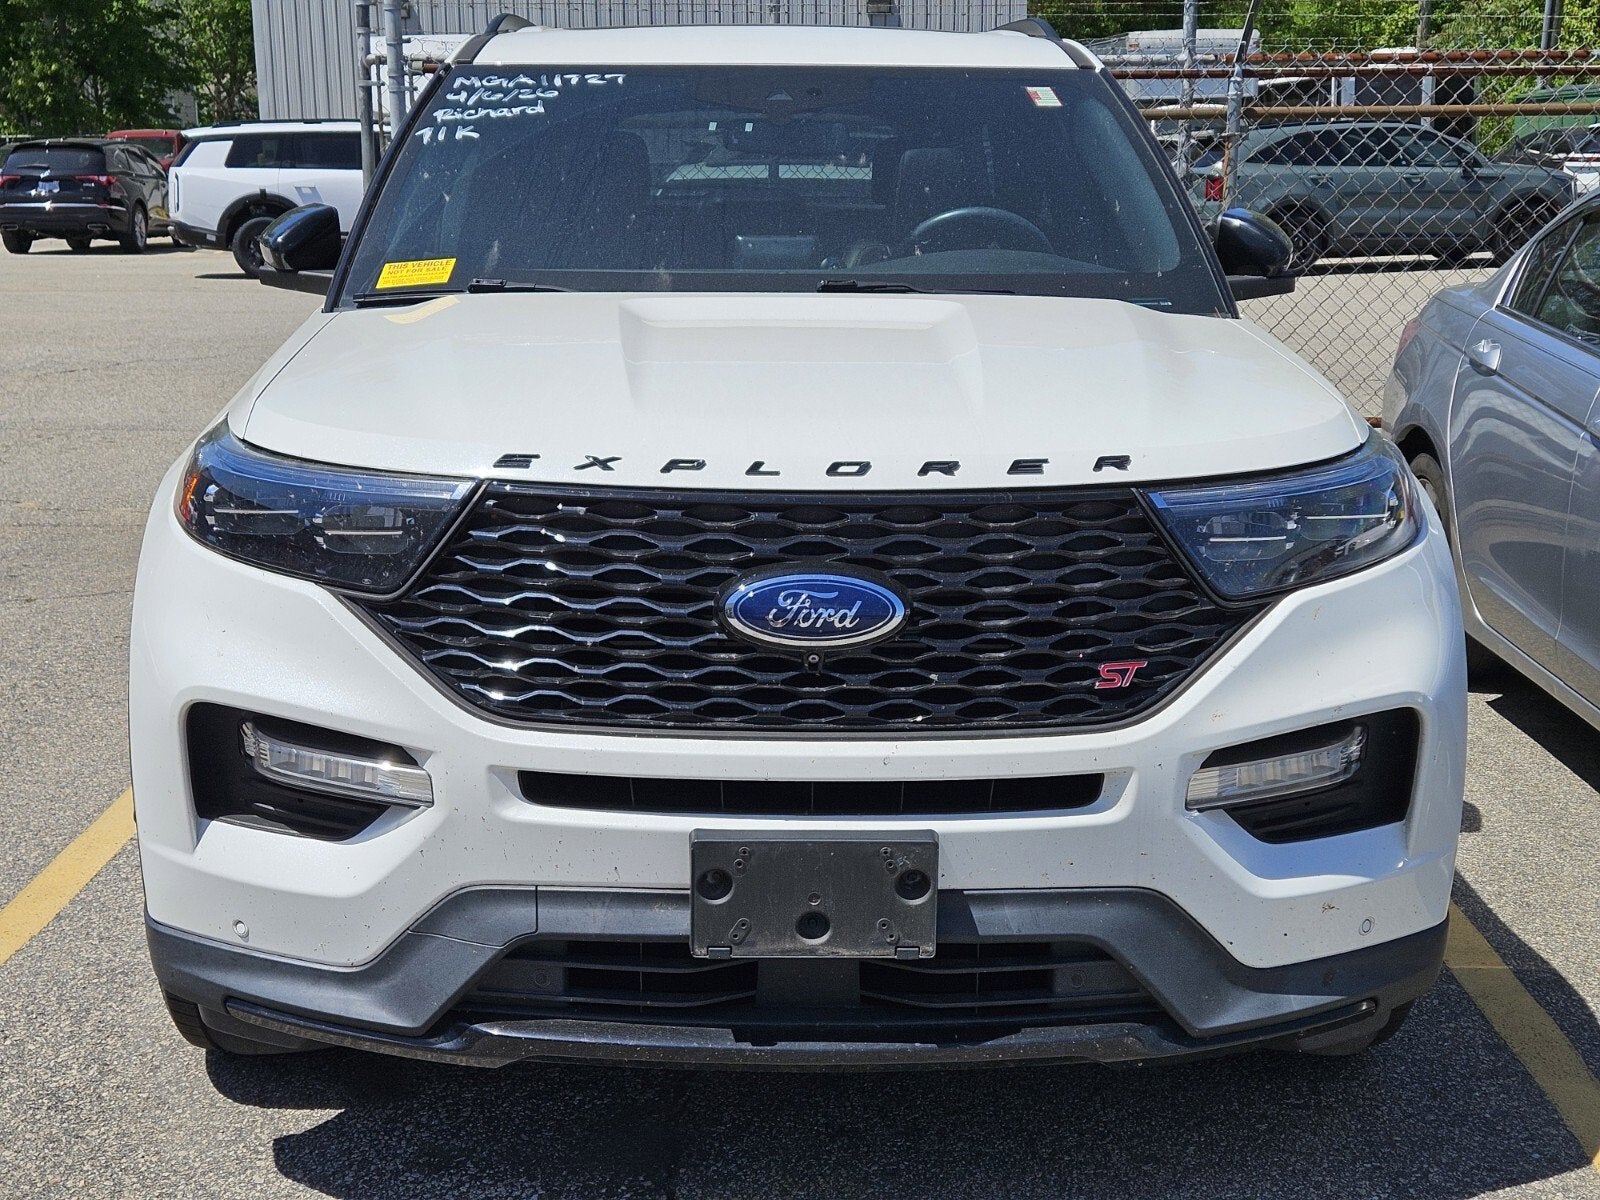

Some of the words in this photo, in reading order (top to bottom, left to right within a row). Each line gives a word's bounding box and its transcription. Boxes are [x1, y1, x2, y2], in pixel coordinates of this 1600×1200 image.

[445, 87, 560, 106] 4/6/26
[432, 100, 545, 123] Richard
[388, 263, 409, 271] THIS
[411, 259, 453, 268] VEHICLE
[492, 452, 1132, 478] EXPLORER
[767, 589, 863, 629] Ford
[1094, 661, 1148, 689] ST
